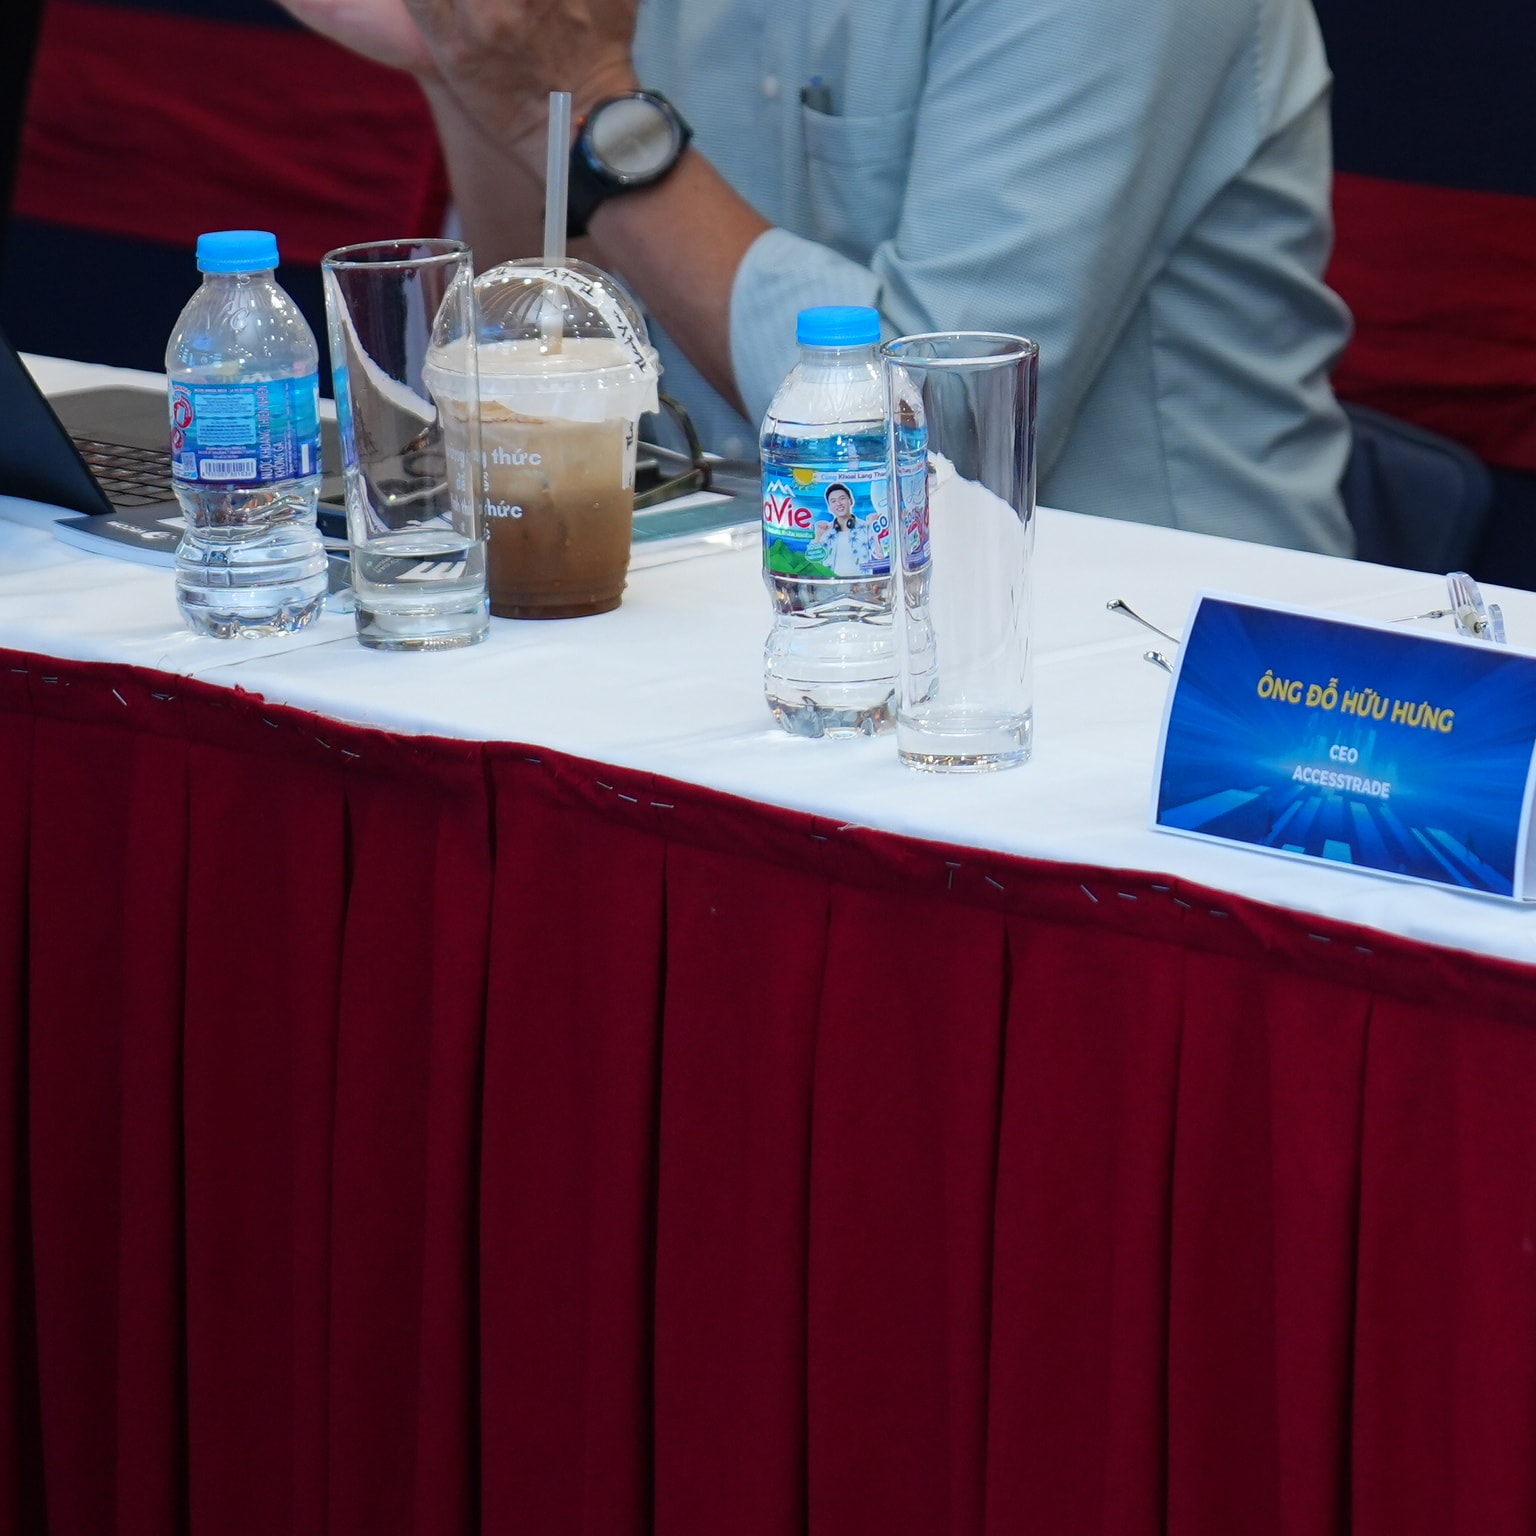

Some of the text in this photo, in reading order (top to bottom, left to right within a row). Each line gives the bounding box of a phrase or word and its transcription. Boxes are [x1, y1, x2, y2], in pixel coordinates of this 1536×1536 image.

[491, 446, 543, 466] thức
[764, 493, 812, 528] aVie
[872, 515, 888, 533] 60
[1256, 669, 1456, 734] ÔNG ĐỖ HỮU HƯNG
[1329, 744, 1359, 765] CEO
[1292, 766, 1392, 800] ACCESSTRADE
